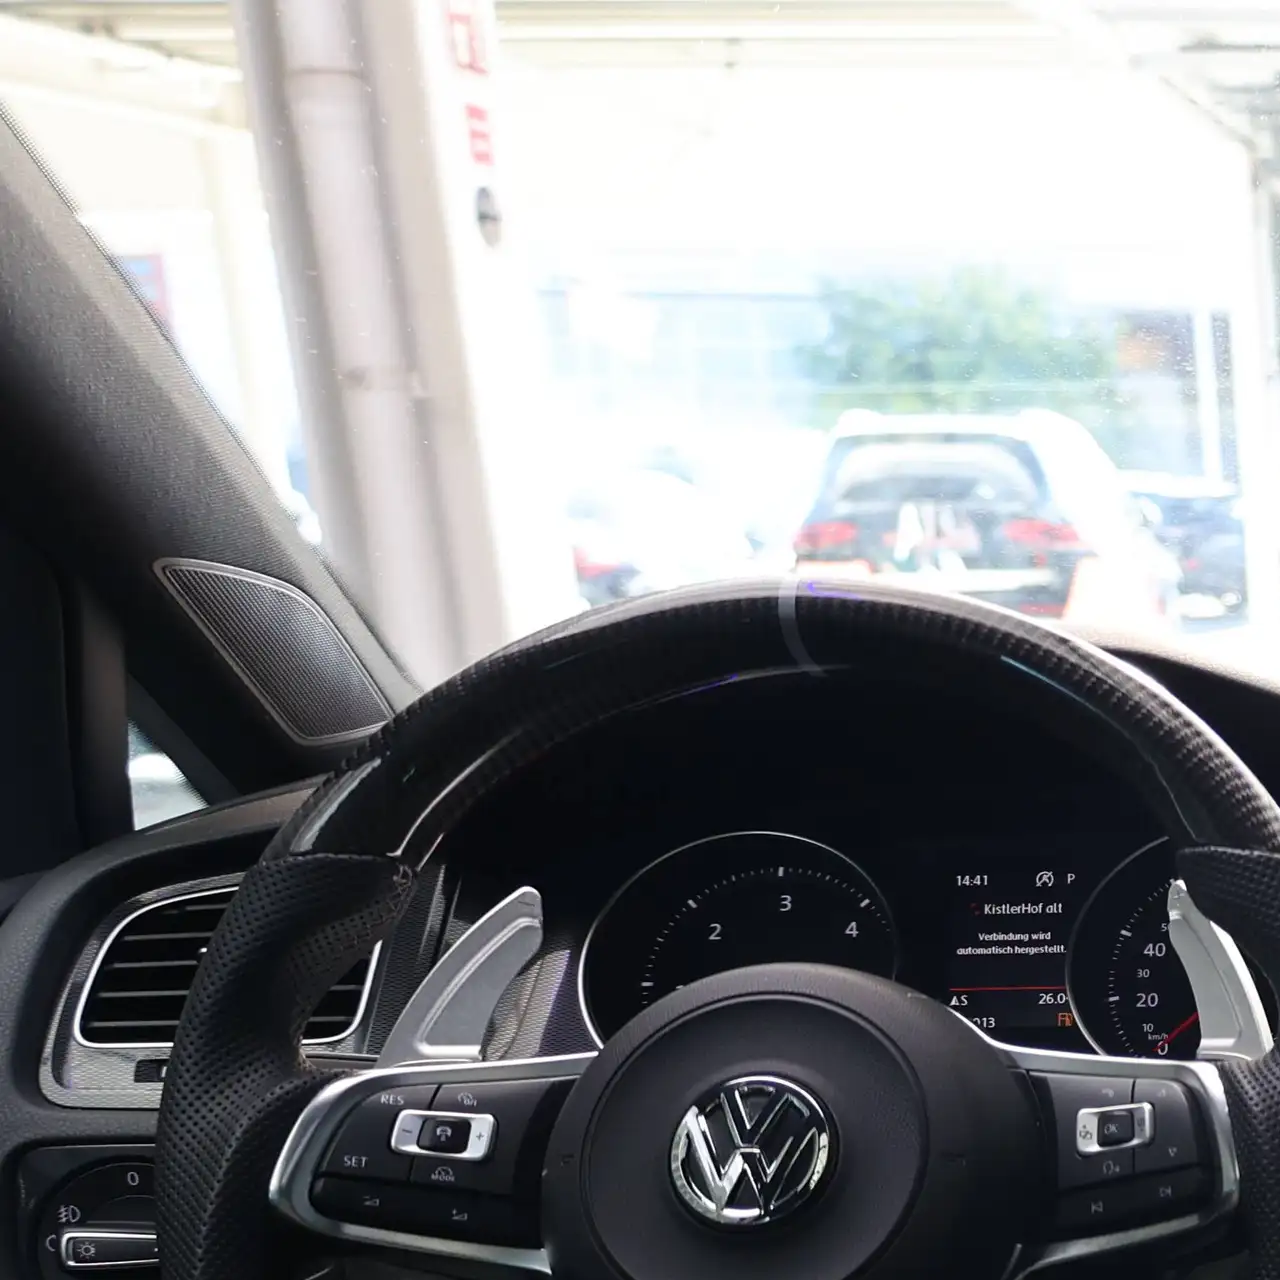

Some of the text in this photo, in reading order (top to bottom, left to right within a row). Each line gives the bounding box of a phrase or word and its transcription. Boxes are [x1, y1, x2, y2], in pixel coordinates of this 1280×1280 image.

[956, 875, 989, 886] 14:41
[1067, 873, 1076, 884] P
[780, 895, 792, 912] 3
[984, 902, 1063, 915] KistlerHof alt
[708, 923, 722, 941] 2
[845, 921, 859, 938] 4
[978, 931, 1051, 941] Verbindung wird
[956, 944, 1067, 955] automatisch hergestellt.
[1143, 942, 1167, 957] 40
[1136, 968, 1150, 978] 30
[1136, 992, 1159, 1008] 20
[1142, 1023, 1154, 1033] 10
[1148, 1033, 1169, 1041] km/h
[380, 1093, 405, 1106] RES
[343, 1155, 368, 1168] SET
